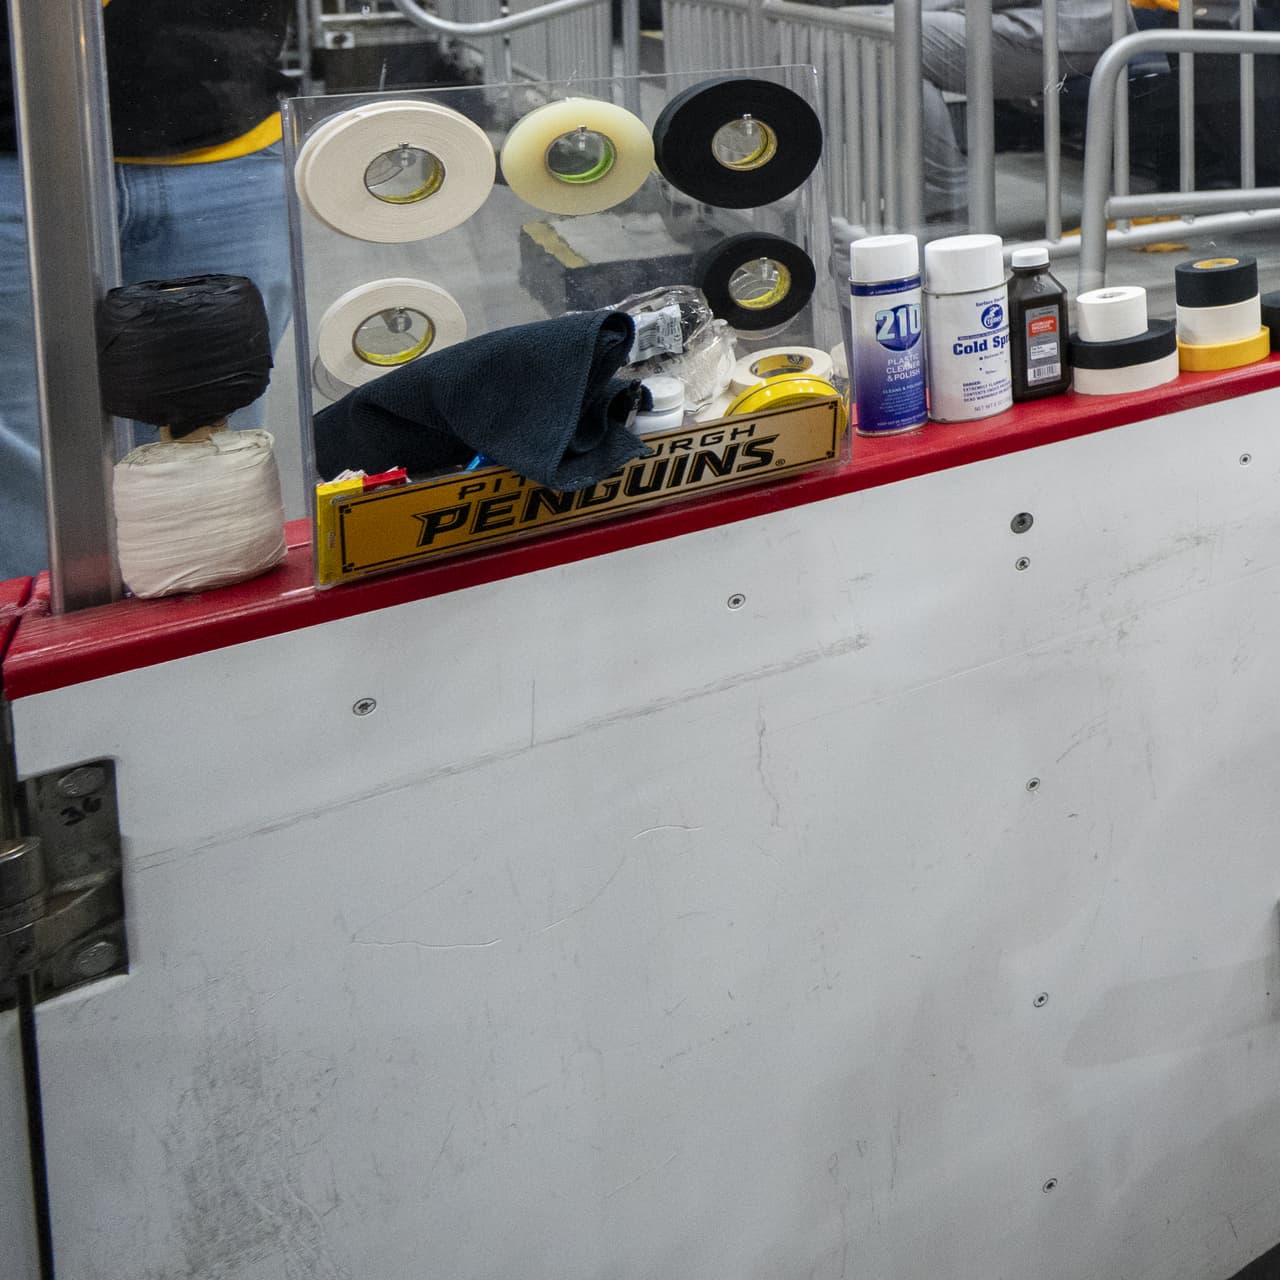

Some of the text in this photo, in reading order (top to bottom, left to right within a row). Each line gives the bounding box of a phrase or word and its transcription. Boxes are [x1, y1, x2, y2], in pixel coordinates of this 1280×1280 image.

[875, 303, 921, 342] 210
[887, 352, 920, 367] PLASTIC
[953, 339, 988, 356] Cold
[894, 367, 921, 382] POLISH
[458, 423, 758, 501] PITURGH
[416, 433, 780, 547] PENGUINS
